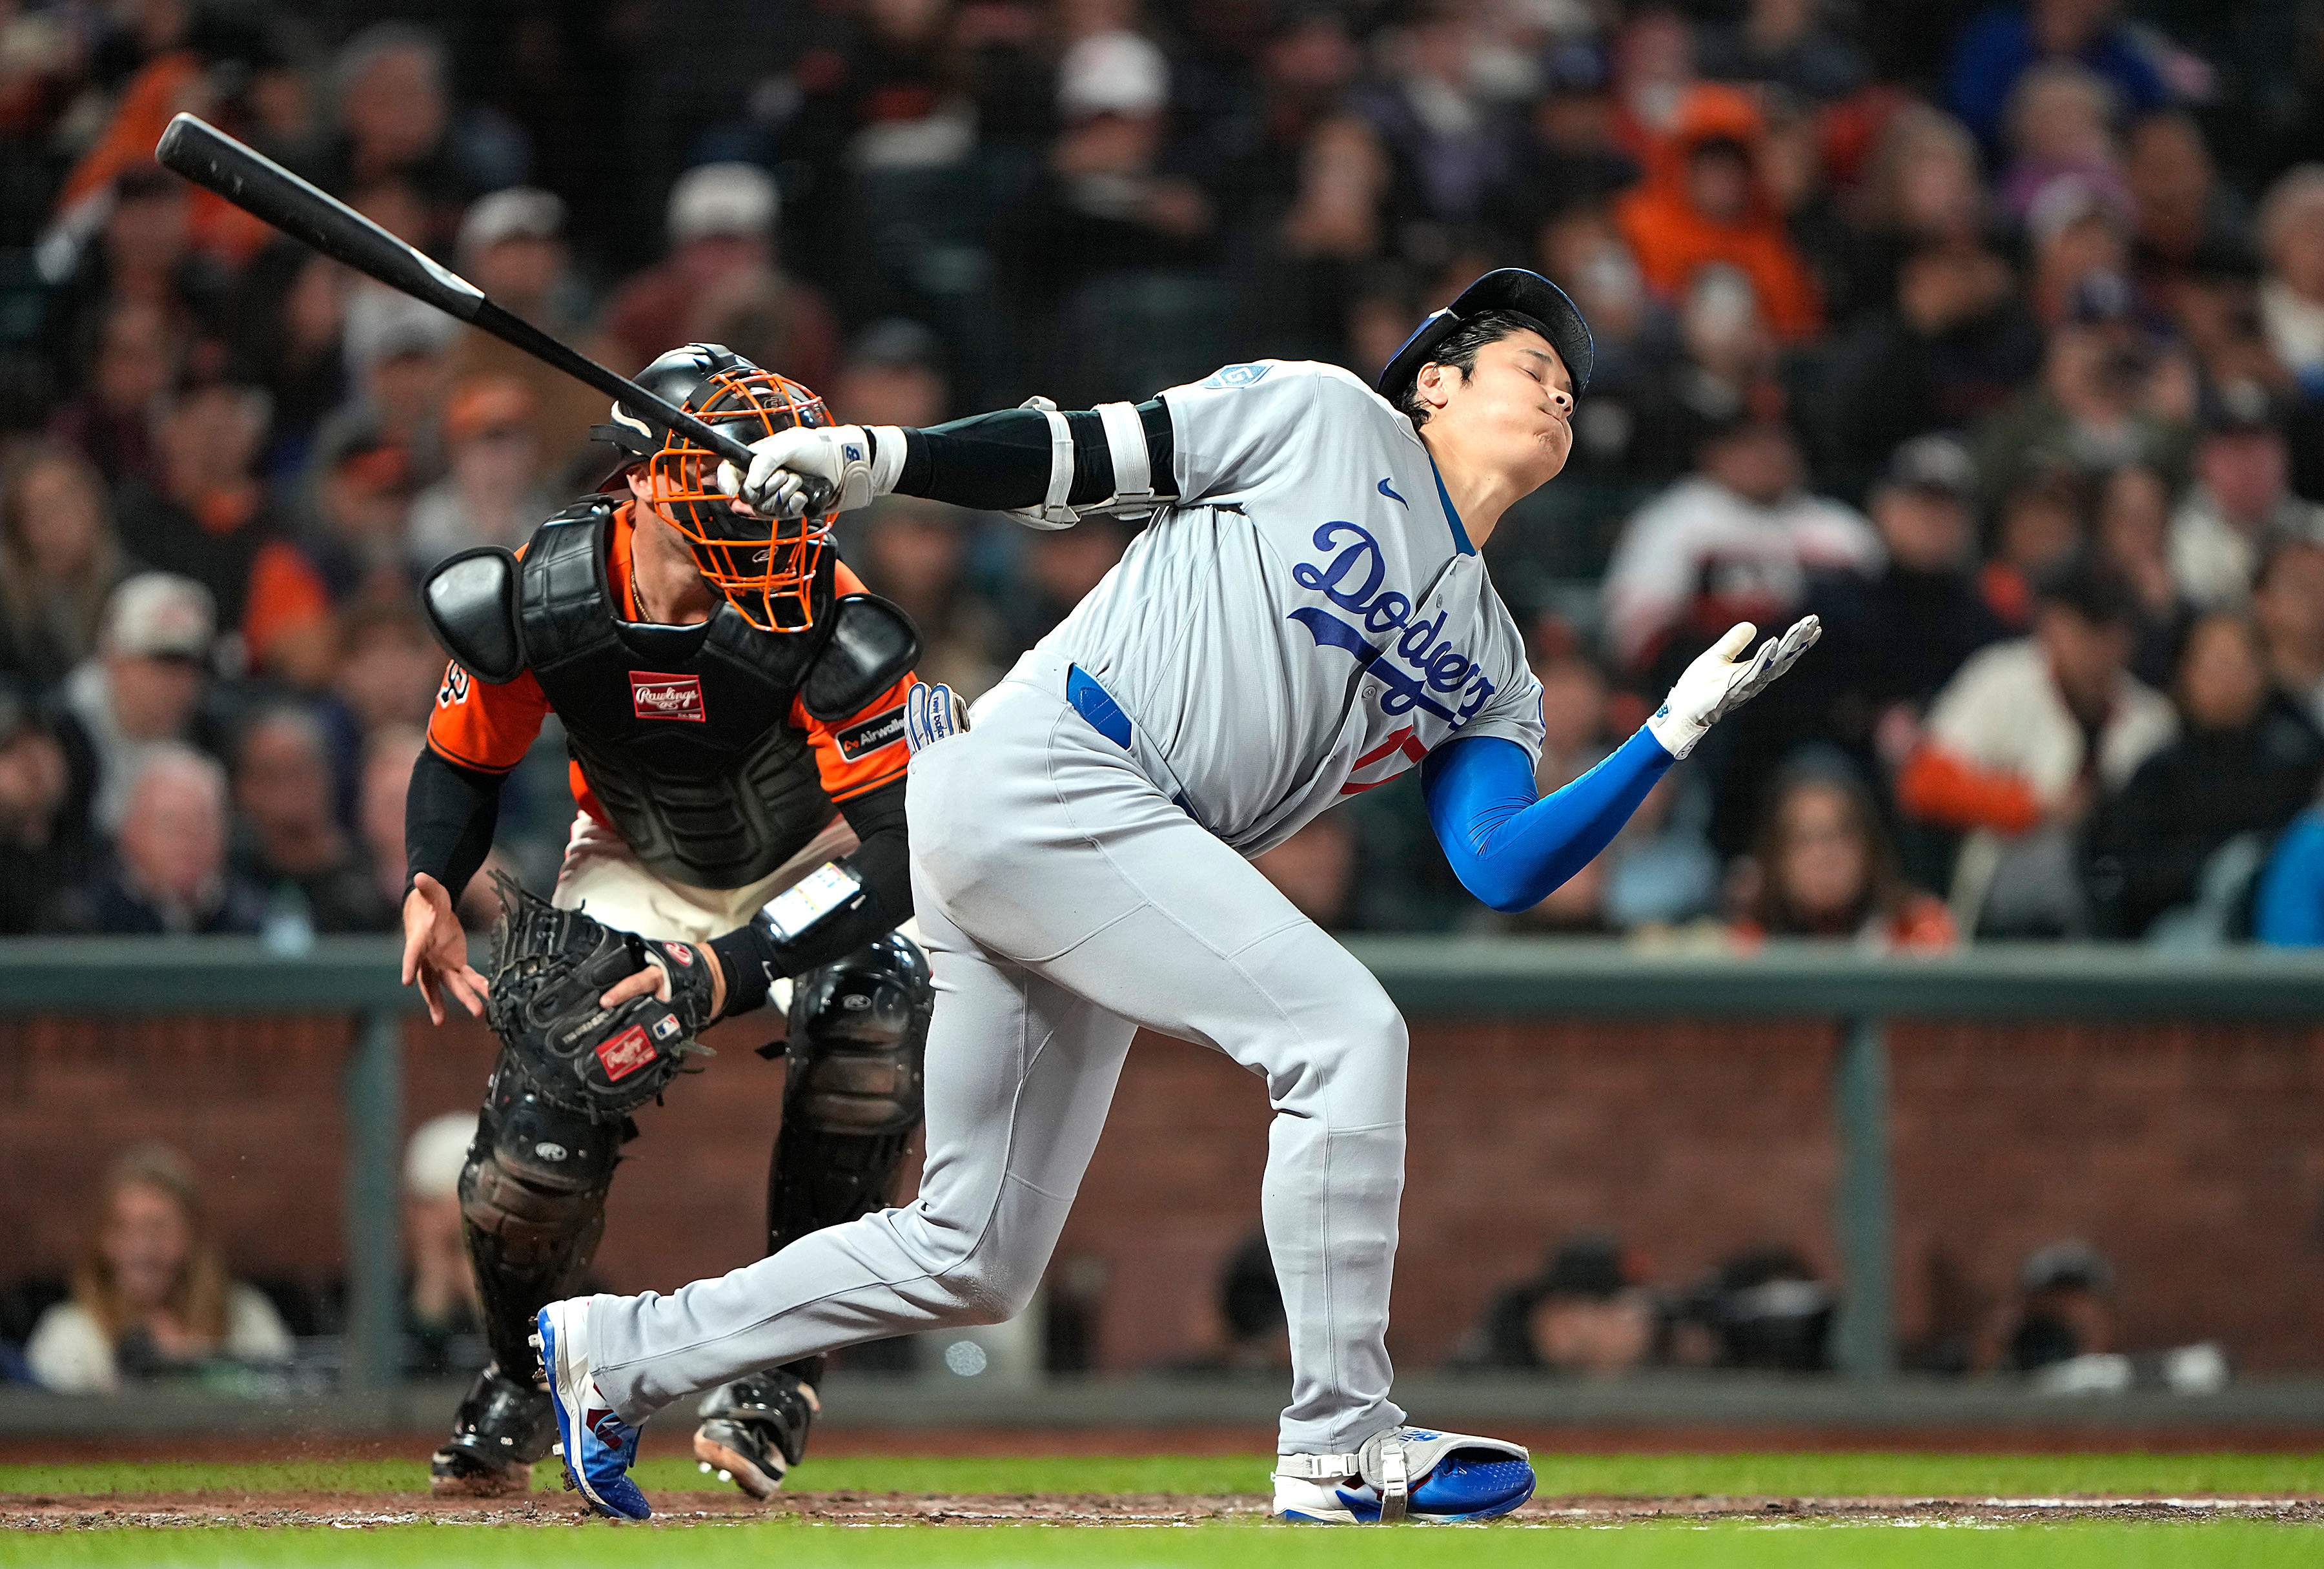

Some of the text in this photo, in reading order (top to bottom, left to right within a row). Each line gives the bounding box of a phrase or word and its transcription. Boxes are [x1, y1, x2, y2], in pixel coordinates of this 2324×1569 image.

[1287, 520, 1495, 731] Dodgers
[635, 686, 699, 708] Rawlings
[860, 718, 904, 746] Airwalle
